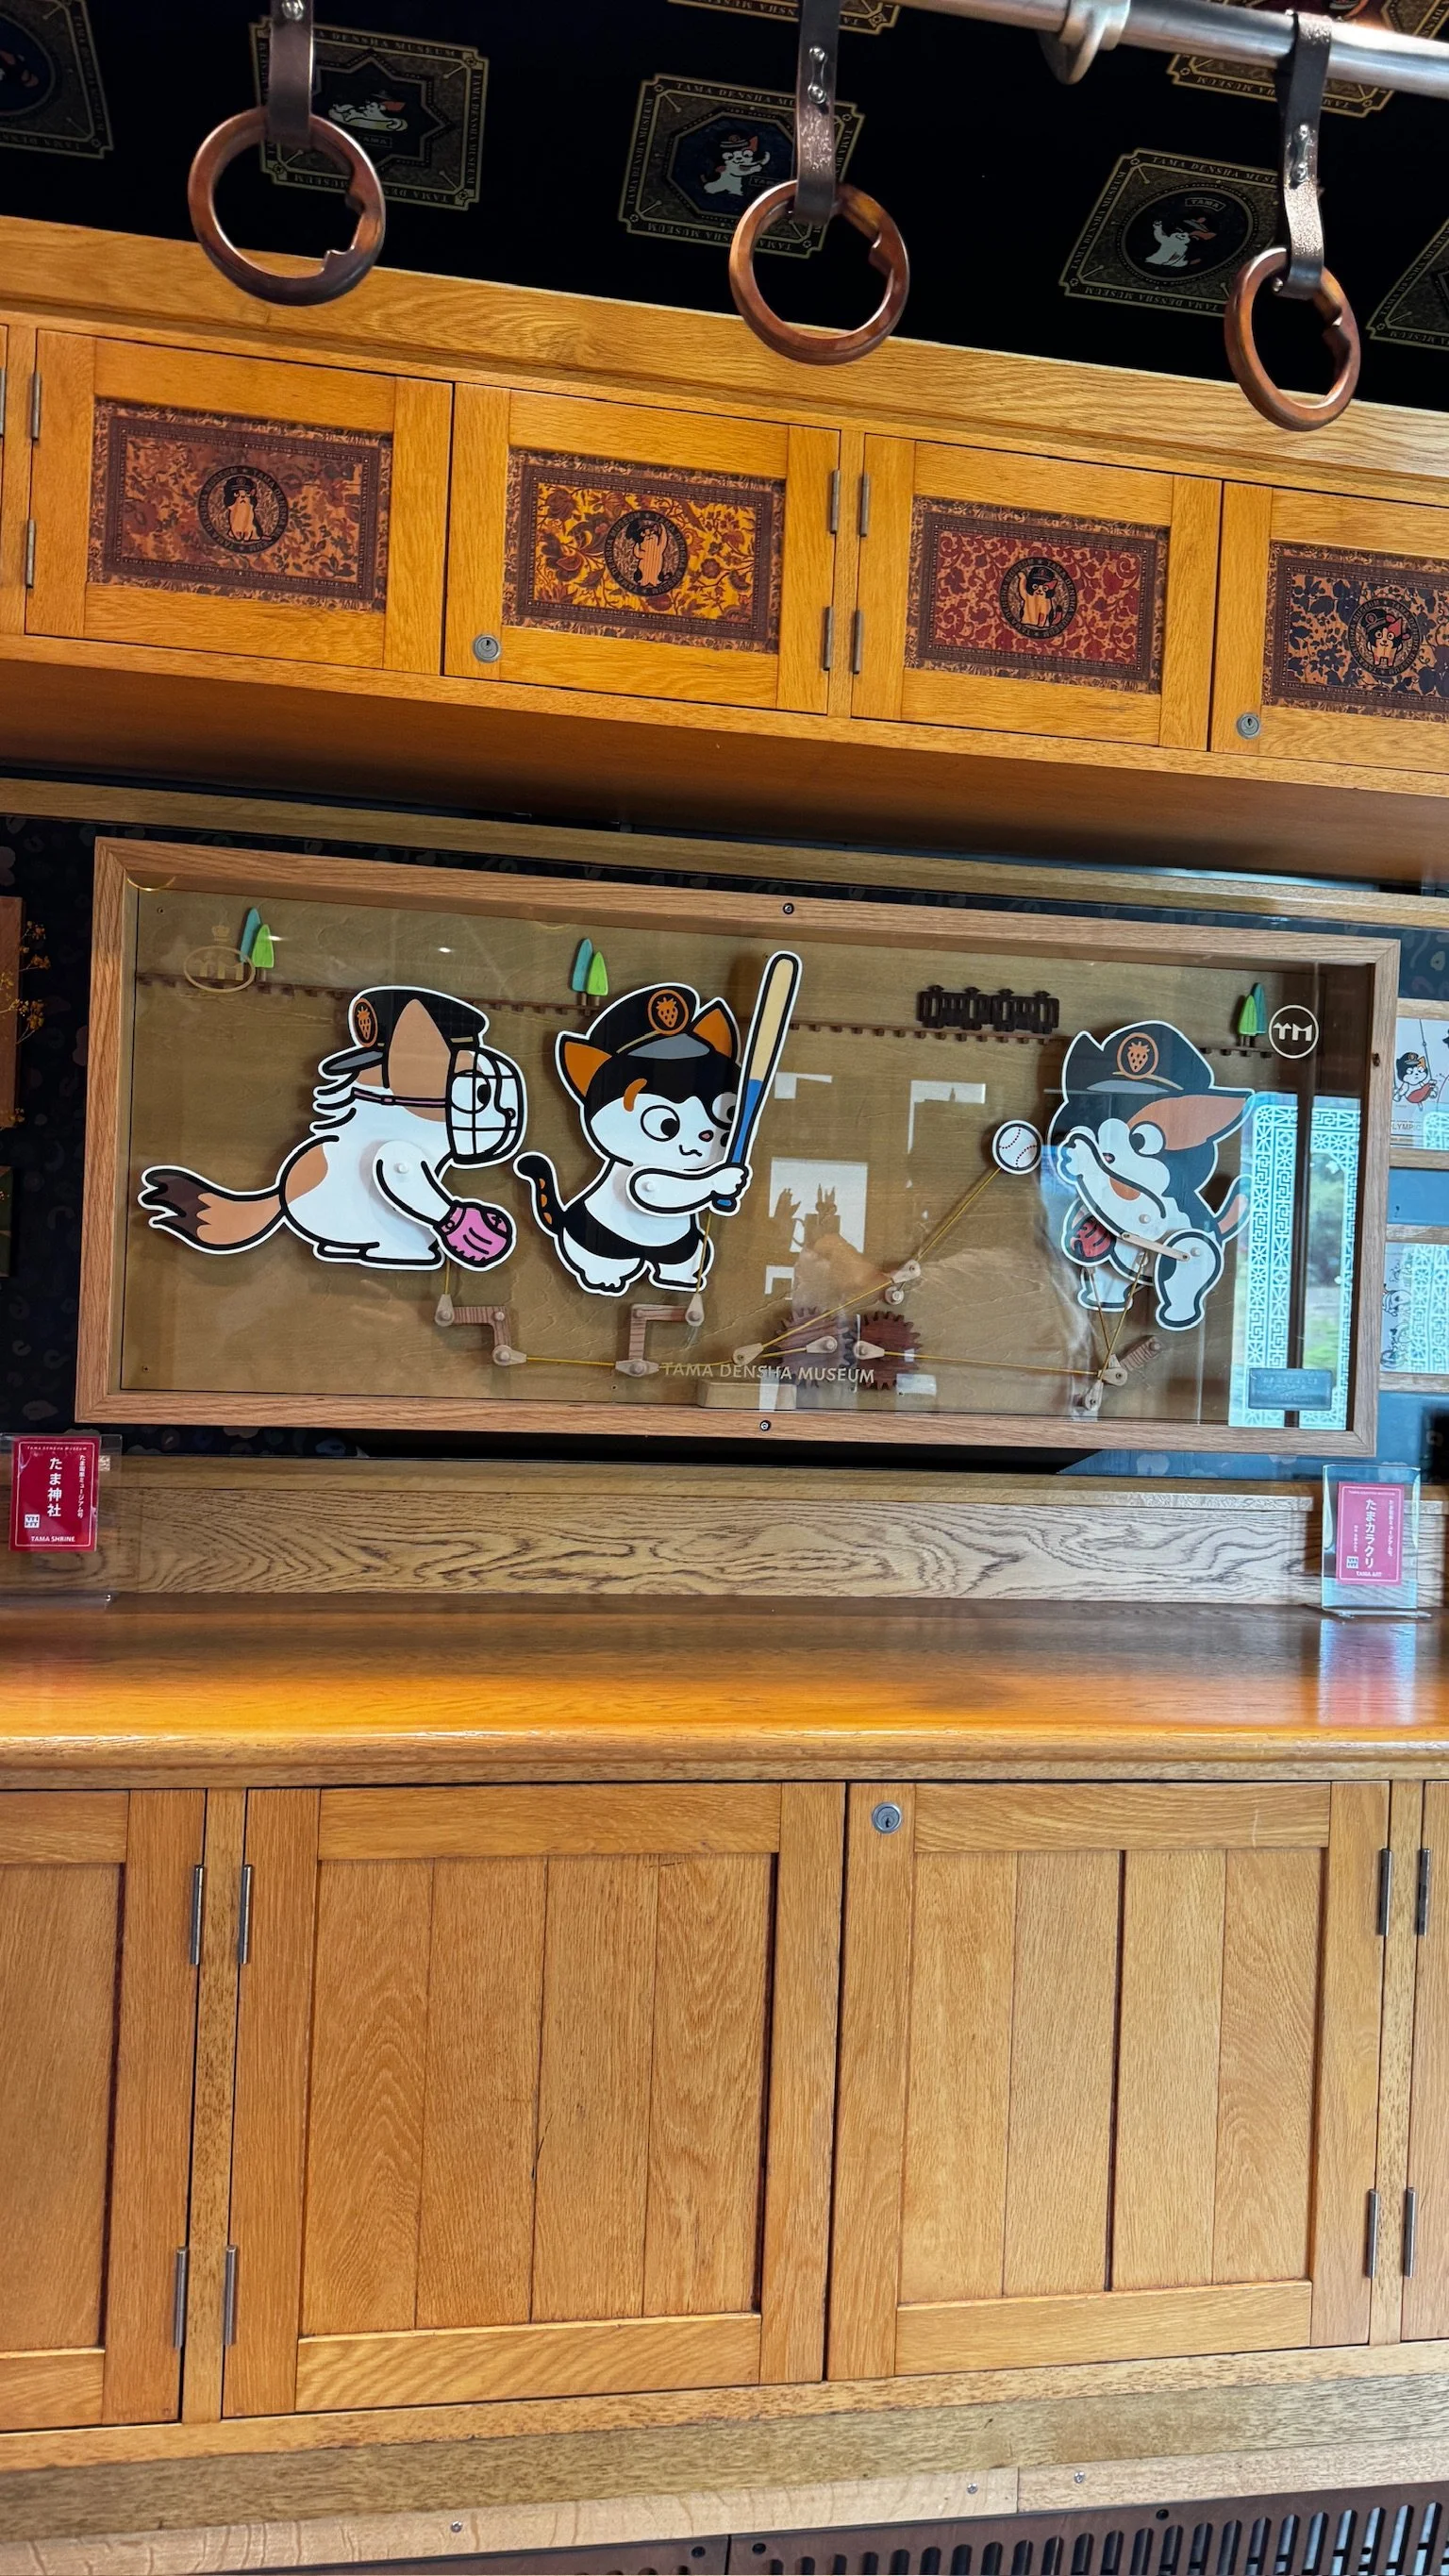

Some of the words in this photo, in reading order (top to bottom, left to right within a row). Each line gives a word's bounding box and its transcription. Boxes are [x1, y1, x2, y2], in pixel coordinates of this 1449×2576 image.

[676, 82, 714, 94] TAMA
[718, 88, 772, 104] DENSHA
[1153, 157, 1186, 170] TAMA
[1191, 162, 1240, 178] DENSHA
[1245, 173, 1277, 184] MUSE
[1191, 199, 1220, 209] TAMA
[1085, 285, 1133, 301] MUSEUM
[1138, 292, 1184, 308] DENSHA
[1188, 298, 1219, 312] TAMA
[663, 1362, 714, 1379] TAMA
[719, 1364, 792, 1380] DENSHA
[796, 1367, 875, 1385] MUSEUM
[47, 1457, 63, 1517] たま神社
[1364, 1498, 1377, 1568] たまカラクリ
